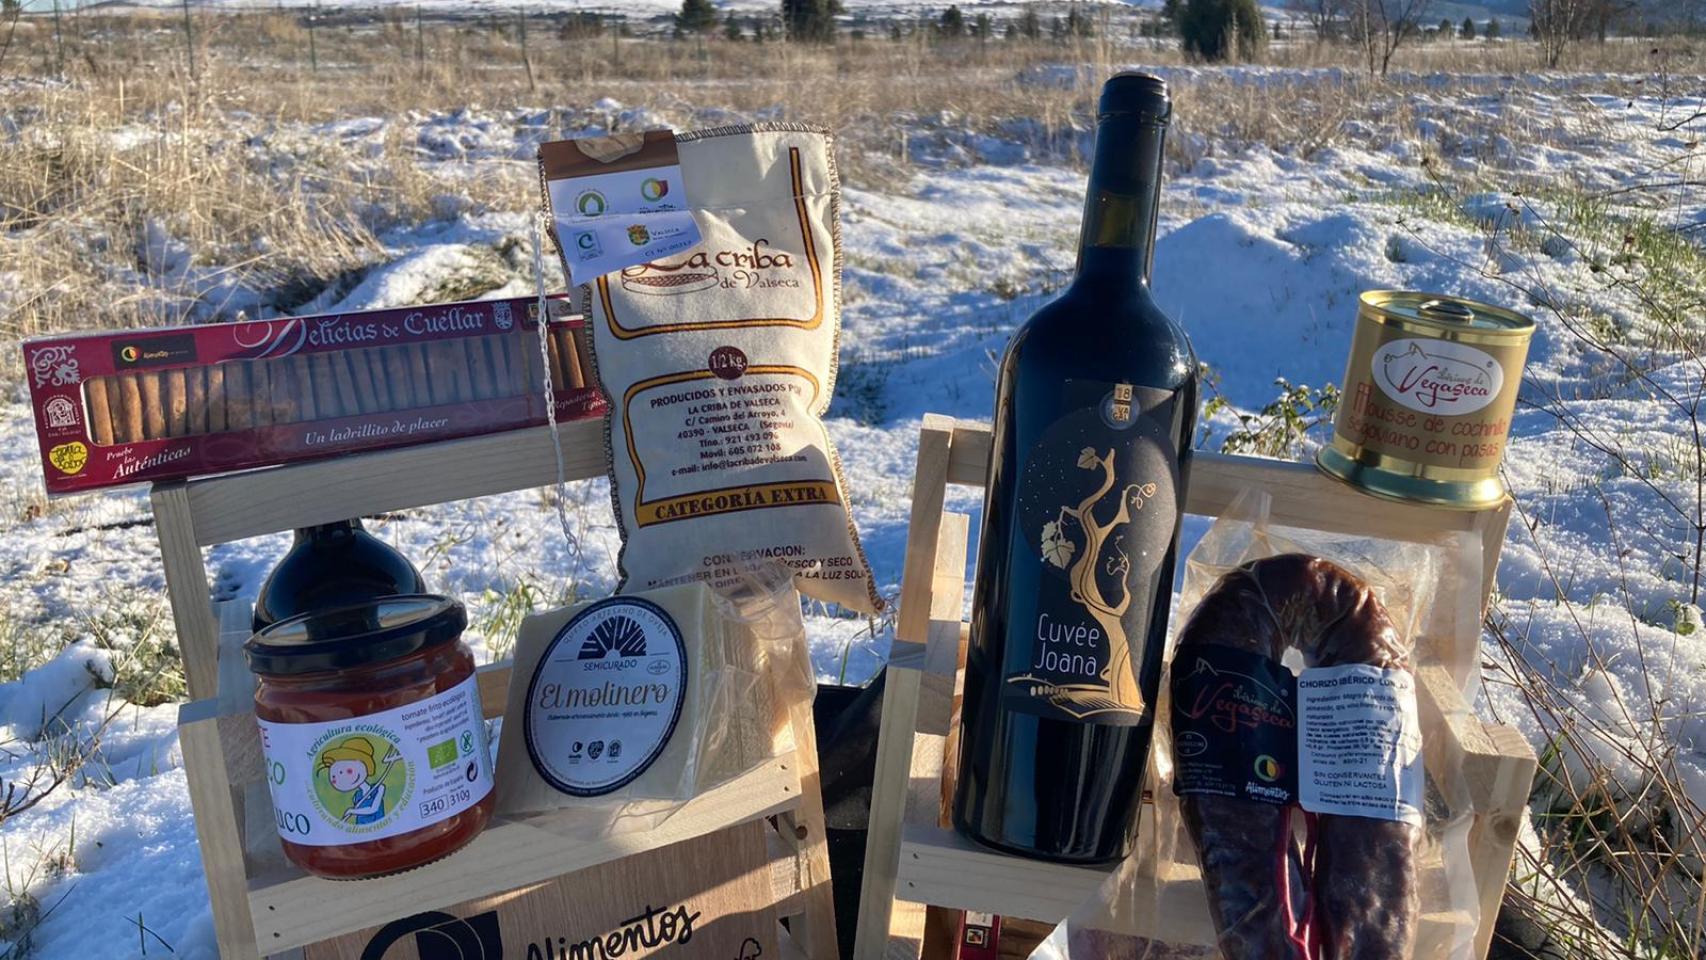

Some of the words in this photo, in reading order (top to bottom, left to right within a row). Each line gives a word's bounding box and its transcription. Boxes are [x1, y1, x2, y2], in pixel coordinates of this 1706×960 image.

[716, 238, 792, 270] criba
[721, 278, 736, 289] de
[733, 270, 799, 289] Valseca
[382, 322, 400, 338] de
[404, 307, 485, 336] Cuéllar
[711, 352, 728, 369] 1/2
[730, 352, 746, 370] kg.
[1398, 364, 1490, 408] Vegaseca
[650, 388, 716, 409] PRODUCIDOS
[718, 387, 725, 397] Y
[728, 383, 786, 397] ENVASADOS
[688, 405, 699, 415] LA
[701, 403, 728, 413] CRIBA
[730, 400, 742, 410] DE
[744, 397, 781, 408] VALSECA
[685, 416, 695, 427] C/
[698, 414, 731, 425] Camino
[732, 410, 745, 421] del
[1423, 416, 1446, 433] de
[305, 431, 325, 446] Un
[329, 423, 389, 442] ladrillito
[392, 420, 406, 434] de
[408, 416, 449, 437] placer
[677, 428, 705, 440] 40390
[712, 423, 750, 435] VALSECA
[725, 436, 742, 446] 921
[743, 433, 762, 444] 493
[1347, 415, 1420, 451] segoviano
[1425, 439, 1457, 456] con
[1460, 442, 1500, 468] pasas
[106, 447, 133, 462] Pruebe
[728, 446, 745, 456] 605
[112, 446, 192, 480] Auténticas
[671, 463, 700, 477] e-mail:
[655, 490, 768, 520] CATEGORÍA
[770, 485, 828, 507] EXTRA
[819, 557, 826, 567] Y
[827, 556, 853, 567] SECO
[821, 570, 842, 580] LUZ
[636, 608, 646, 618] DE
[1037, 612, 1100, 648] Cuvée
[583, 659, 638, 672] SEMICURADO
[1034, 642, 1097, 676] Joana
[1300, 680, 1338, 689] CHORIZO
[1339, 675, 1376, 686] IBÉRICO
[401, 707, 428, 721] tomate
[1191, 682, 1294, 733] Vegaseca
[306, 724, 353, 759] Agricultura
[354, 723, 402, 745] ecológica
[1313, 778, 1343, 788] GLUTEN
[1353, 780, 1387, 790] LACTOSA
[422, 799, 446, 816] 340
[450, 789, 470, 807] 310g
